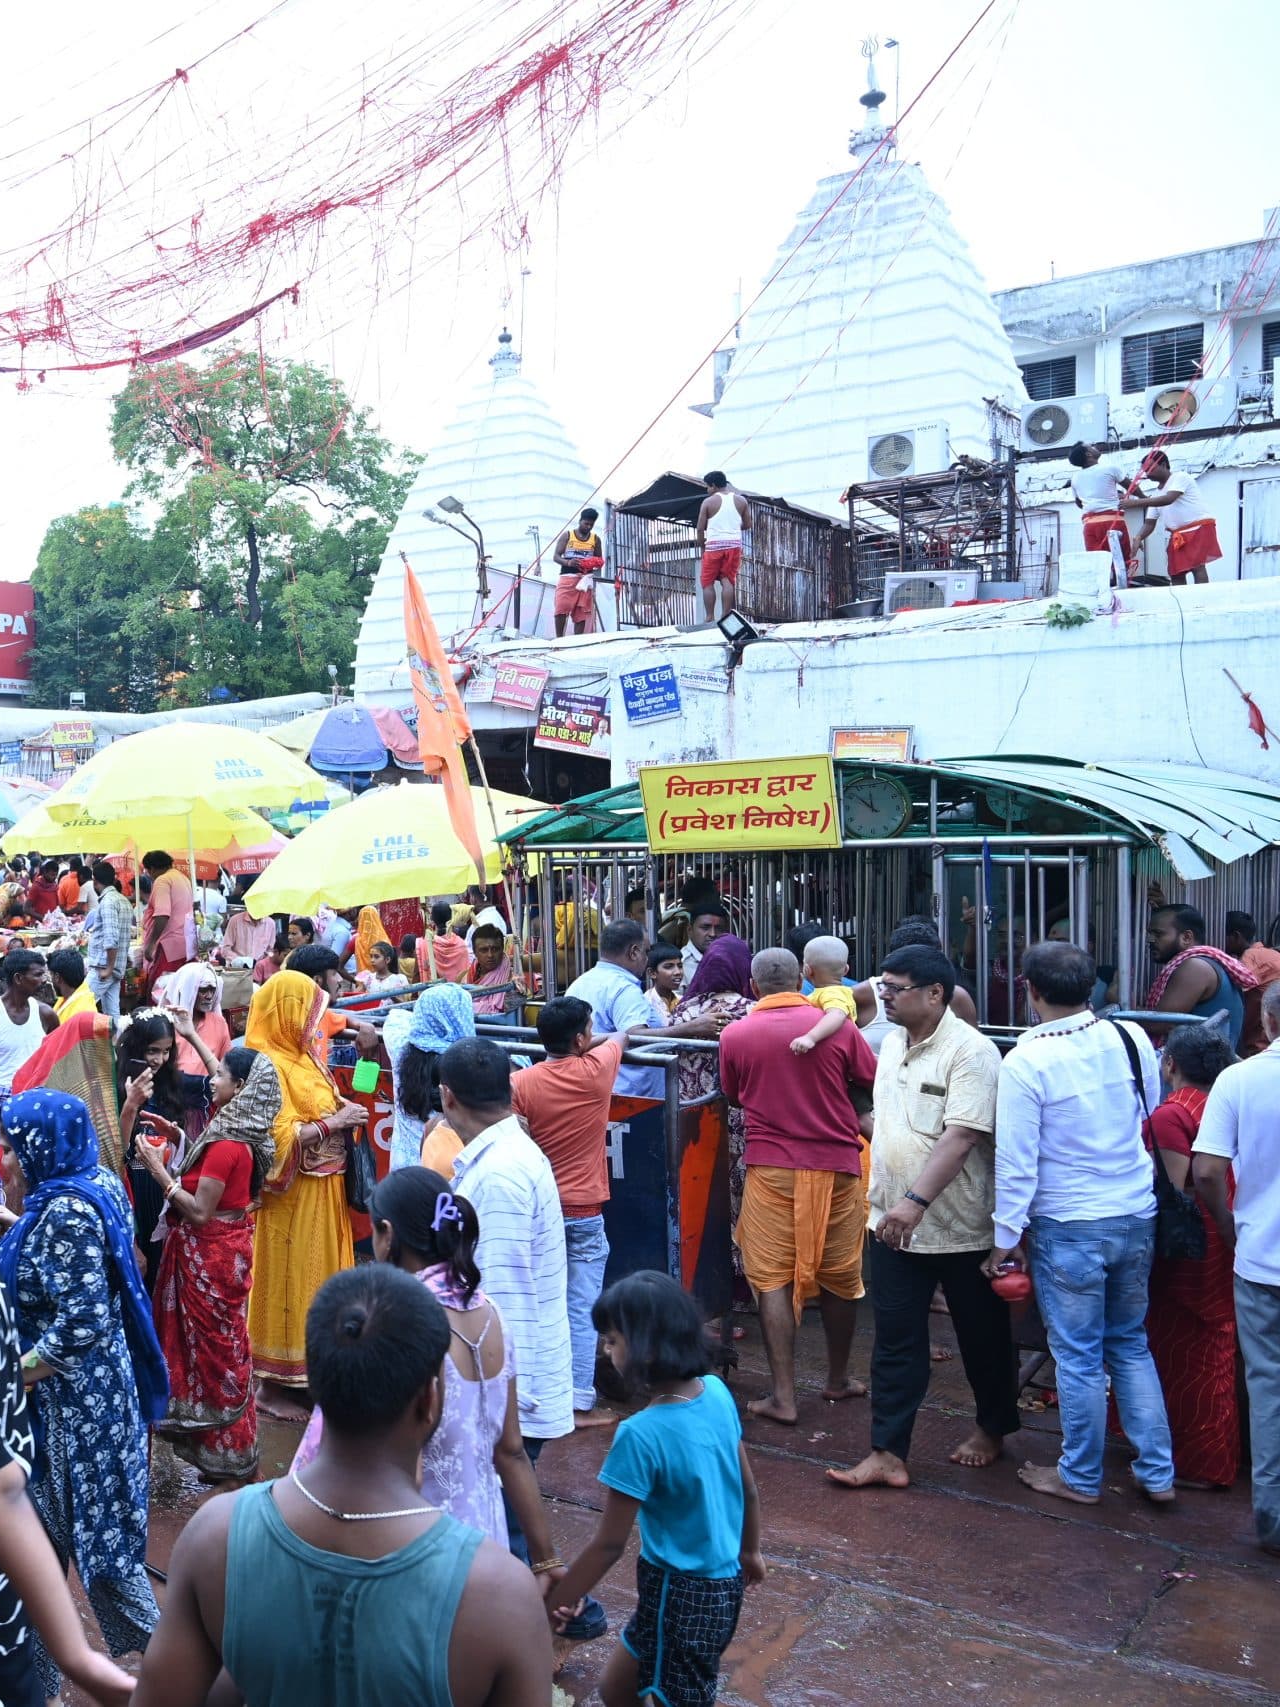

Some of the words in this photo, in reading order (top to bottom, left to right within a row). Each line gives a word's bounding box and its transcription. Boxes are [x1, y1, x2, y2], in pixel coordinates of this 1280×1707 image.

[519, 673, 544, 691] बाबा
[648, 668, 673, 682] पंडा
[543, 706, 568, 722] भीम
[214, 768, 264, 780] STEELS
[665, 775, 762, 799] निकास
[767, 773, 817, 798] द्वार
[62, 819, 108, 828] STEELS
[659, 807, 736, 839] (प्रवेश
[742, 801, 831, 834] निषेध)
[373, 834, 415, 848] LALL
[362, 847, 430, 864] STEELS
